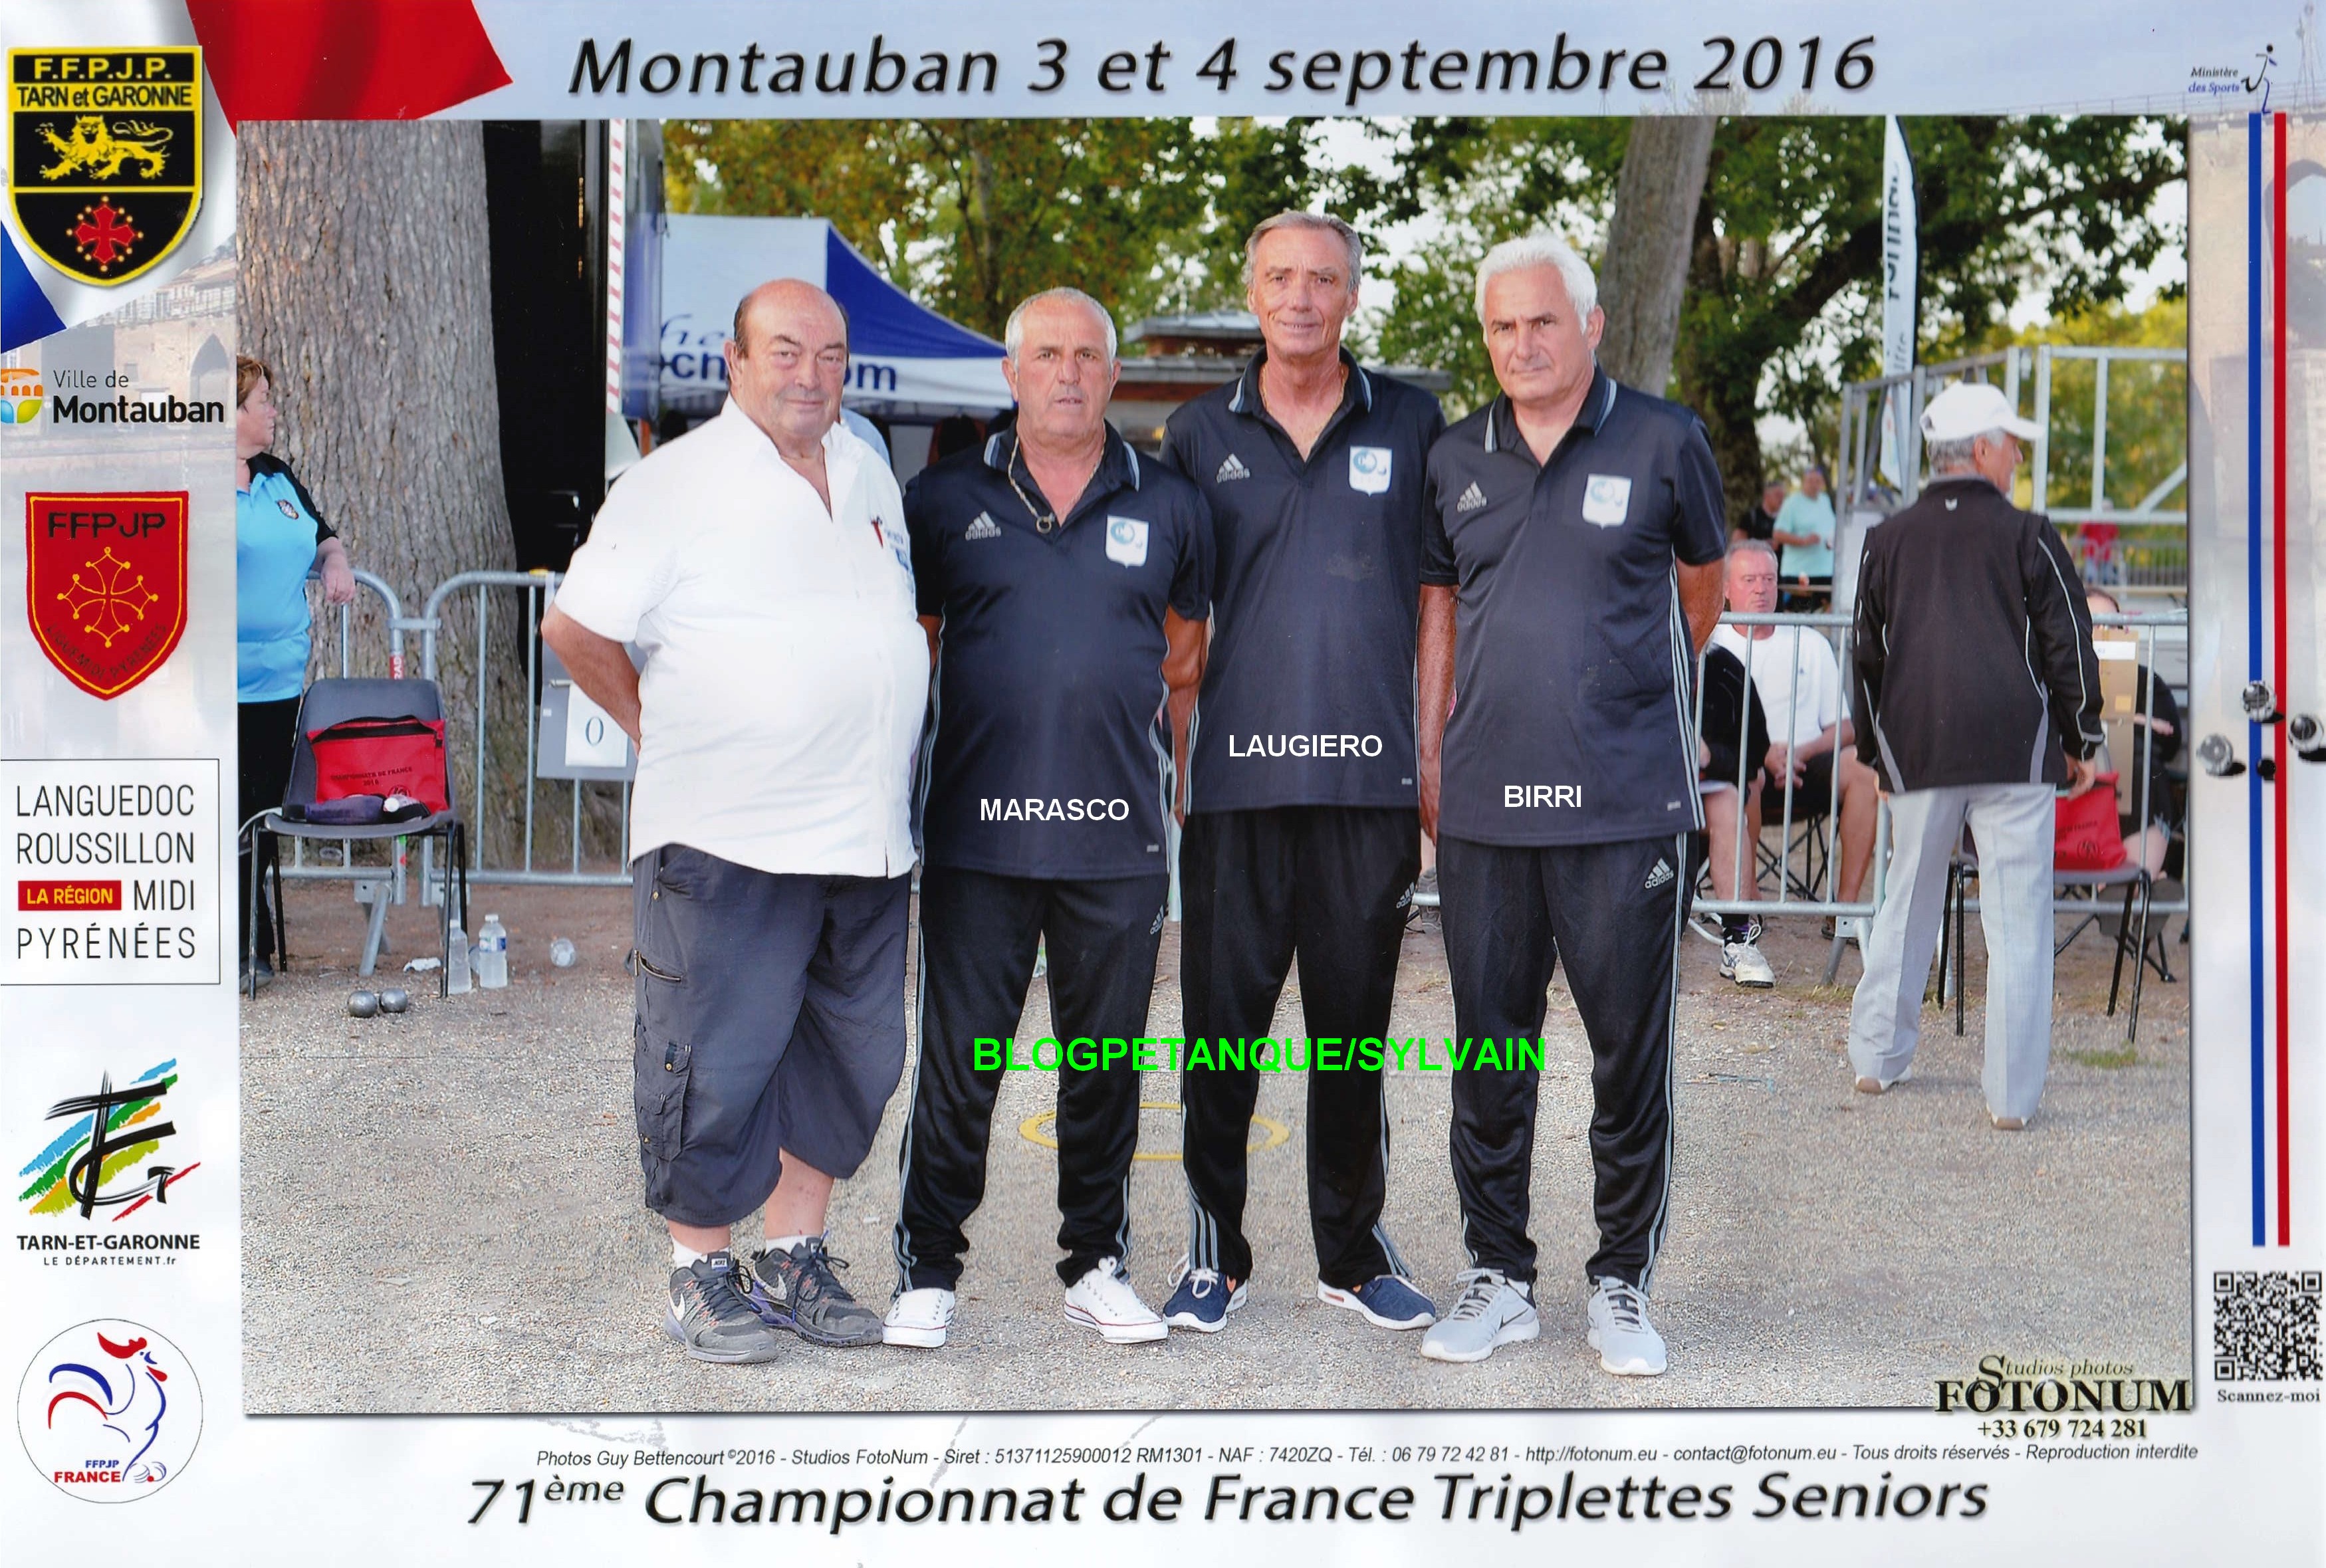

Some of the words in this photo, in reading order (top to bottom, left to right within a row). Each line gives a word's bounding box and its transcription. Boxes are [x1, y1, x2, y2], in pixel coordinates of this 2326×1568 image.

[1216, 467, 1250, 483] adidas
[965, 526, 1001, 541] adidas
[388, 766, 413, 776] FRANCE
[1645, 869, 1675, 889] adidas
